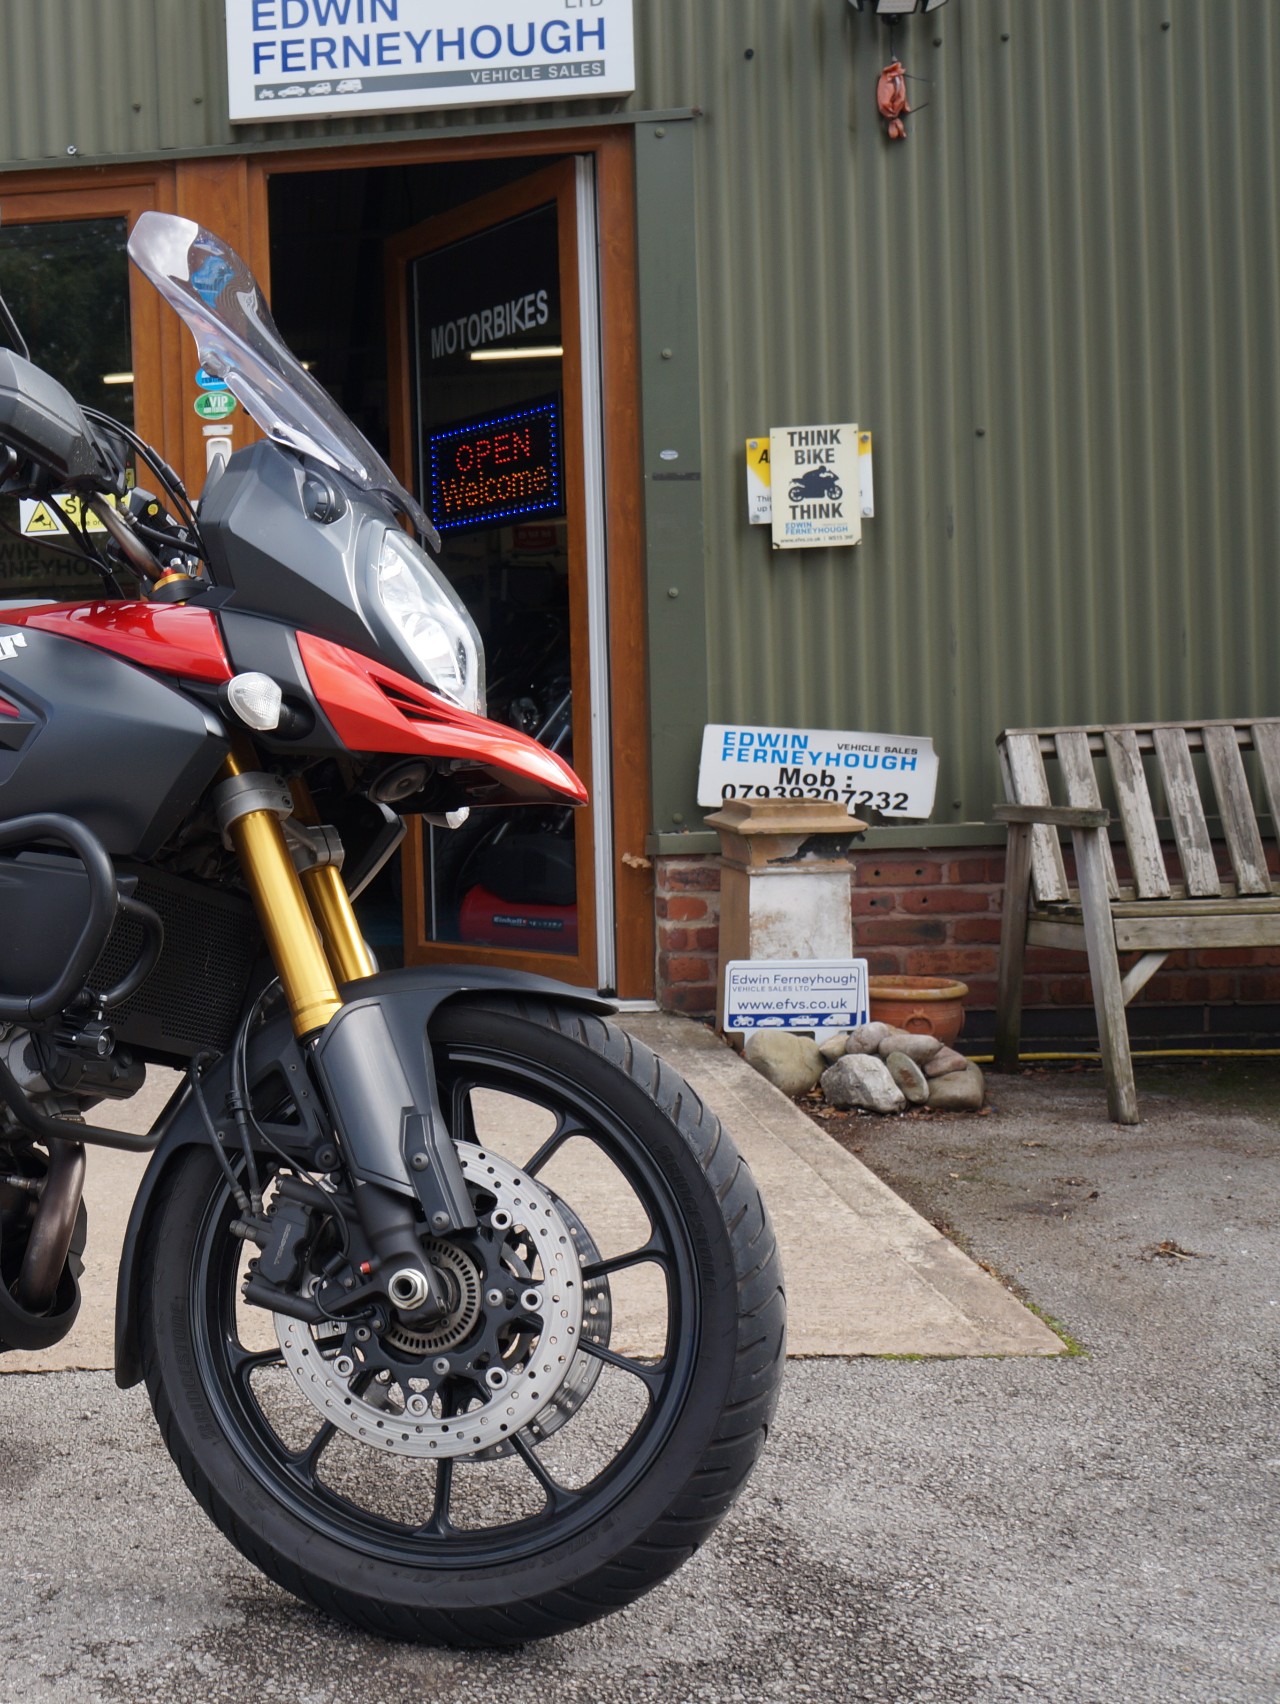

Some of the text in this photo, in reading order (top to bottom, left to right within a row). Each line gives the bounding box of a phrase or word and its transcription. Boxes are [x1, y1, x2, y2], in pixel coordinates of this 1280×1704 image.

[251, 0, 399, 31] EDWIN
[253, 18, 605, 75] FERNEYHOUGH
[470, 62, 602, 84] VEHICLE SALES
[431, 290, 548, 359] MOTORBIKES
[787, 429, 842, 447] THINK
[455, 428, 531, 472] OPEN
[794, 448, 835, 465] BIKE
[441, 466, 548, 513] Welcome
[789, 503, 843, 520] THINK
[723, 731, 808, 749] EDWIN
[837, 743, 918, 755] VEHICLE SALES
[721, 747, 917, 771] FERNEYHOUGH
[779, 767, 835, 788] Mob
[732, 973, 857, 986] Edwin Ferneyhough
[737, 998, 847, 1010] www.efvs.co.uk
